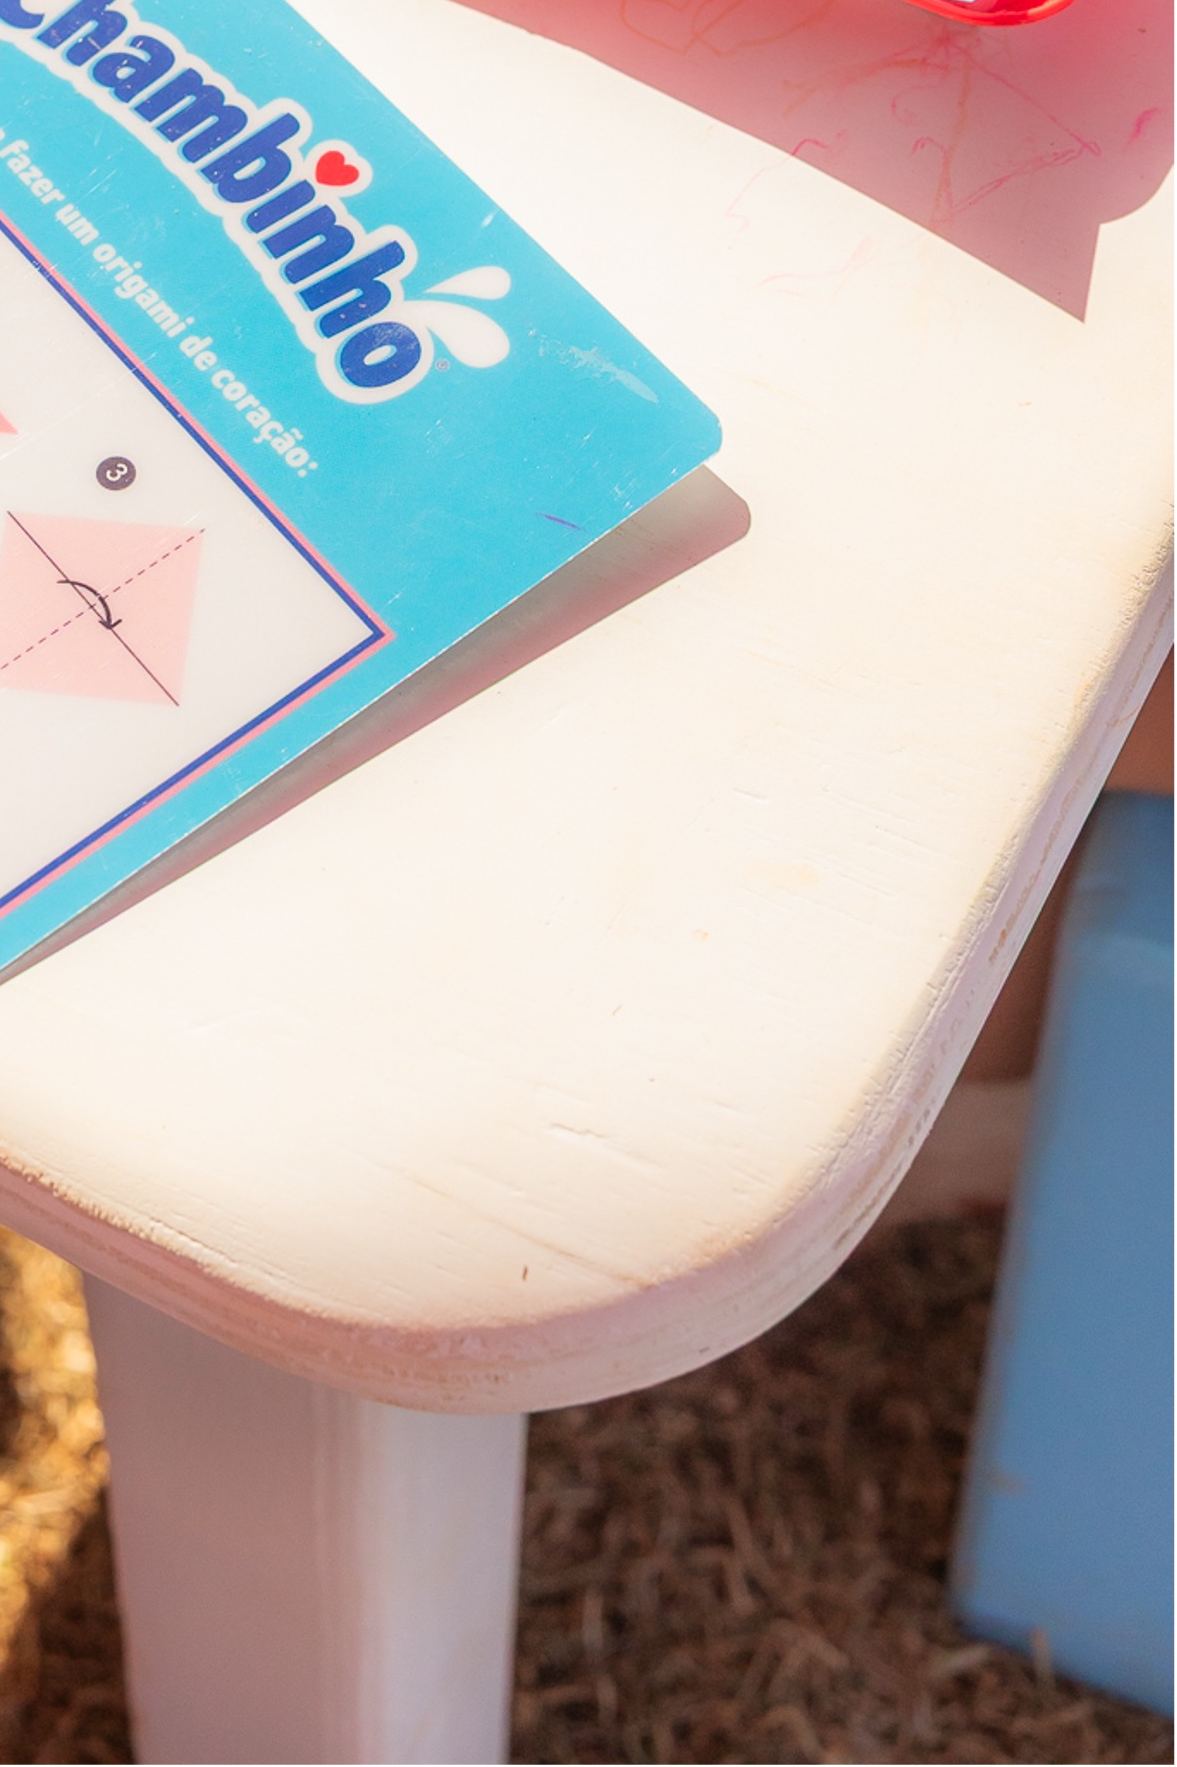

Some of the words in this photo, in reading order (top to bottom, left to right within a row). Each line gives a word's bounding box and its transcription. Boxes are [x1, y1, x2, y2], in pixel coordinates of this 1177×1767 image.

[55, 203, 100, 246] um
[92, 242, 195, 338] origami
[179, 335, 217, 372] de
[211, 369, 318, 478] coração:
[107, 464, 127, 481] 3
